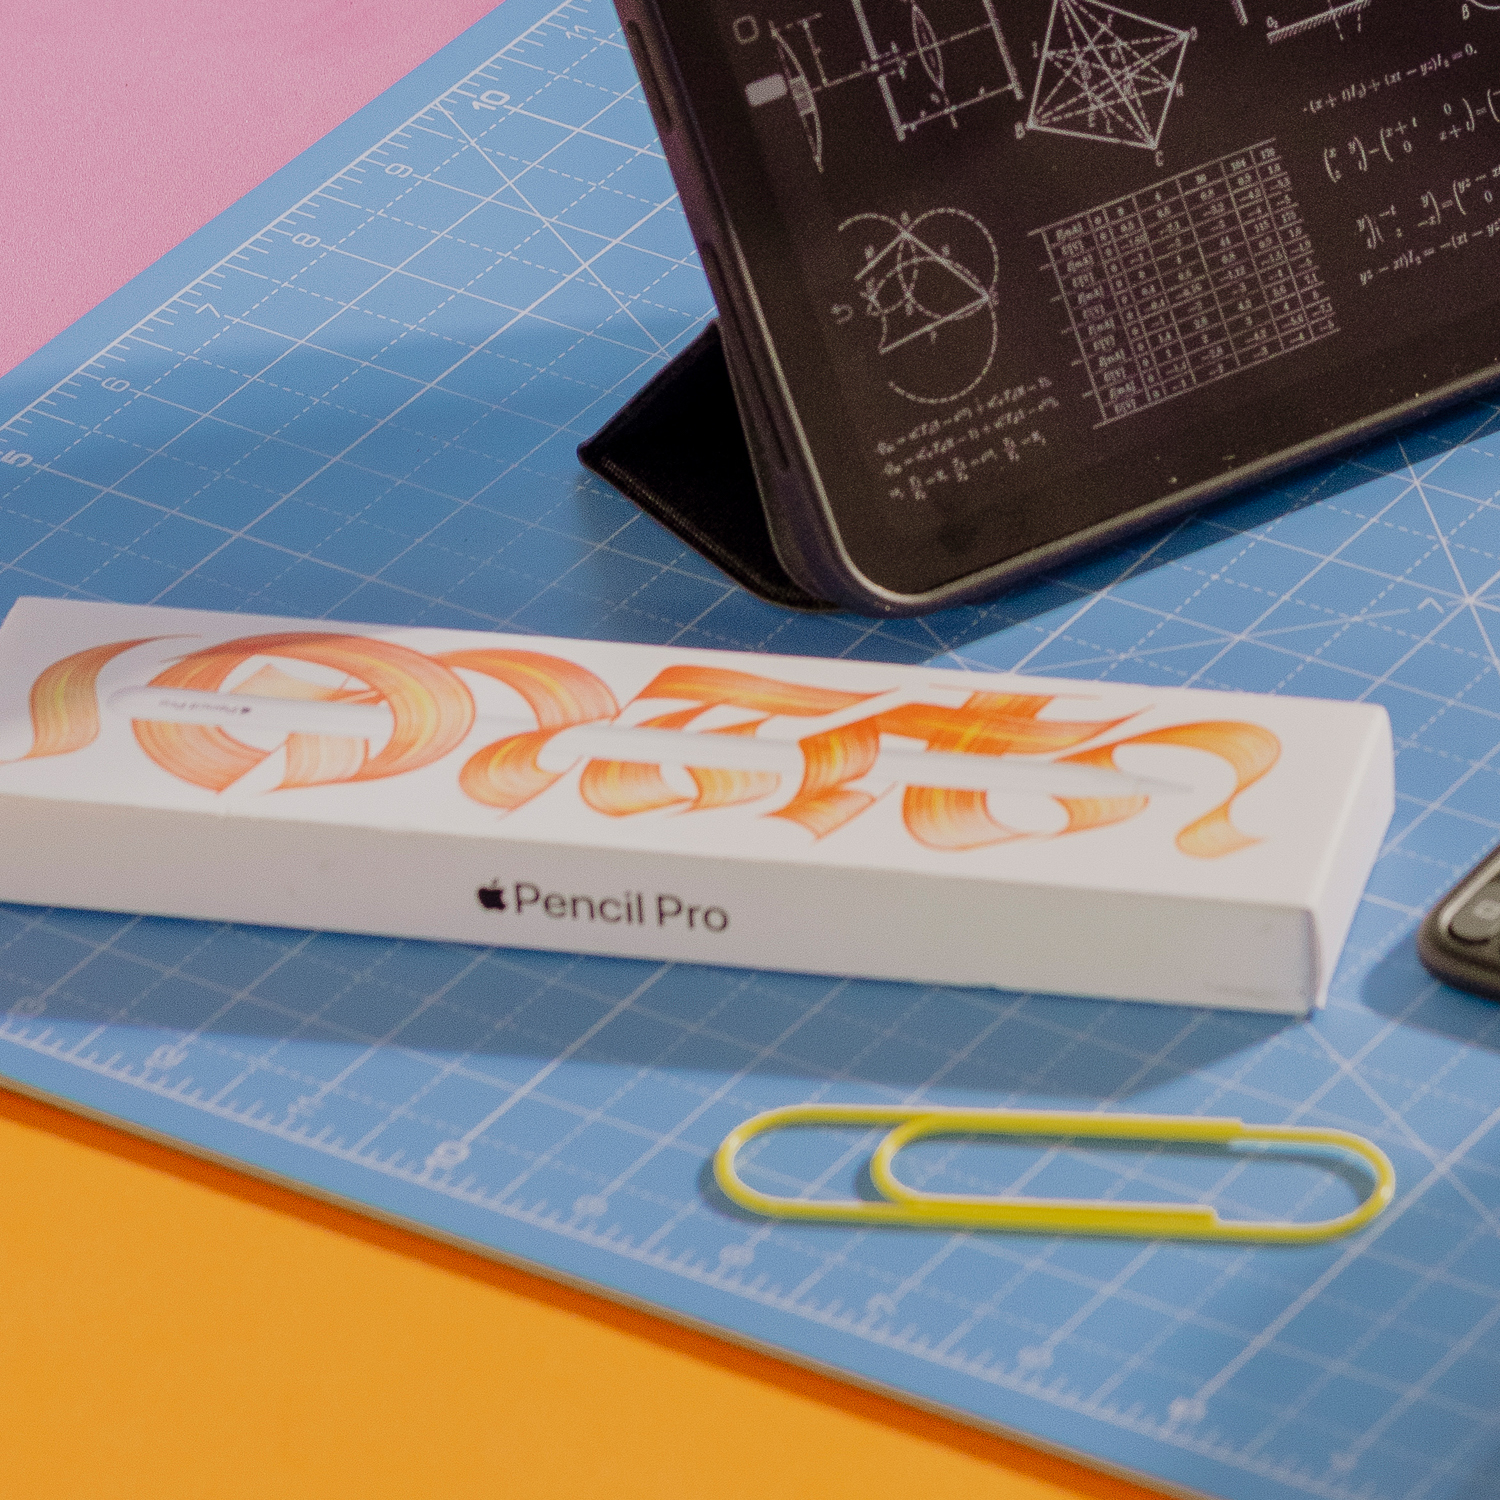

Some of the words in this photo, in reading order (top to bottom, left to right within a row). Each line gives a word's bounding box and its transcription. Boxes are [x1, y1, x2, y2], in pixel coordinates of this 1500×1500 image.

[564, 23, 598, 42] 11
[471, 87, 512, 115] 10
[383, 161, 415, 179] 9
[291, 231, 322, 249] 8
[194, 301, 222, 321] 7
[103, 376, 132, 395] 6
[2, 450, 34, 468] 5
[1416, 595, 1446, 615] 7
[514, 881, 644, 926] Pencil
[656, 892, 730, 933] Pro
